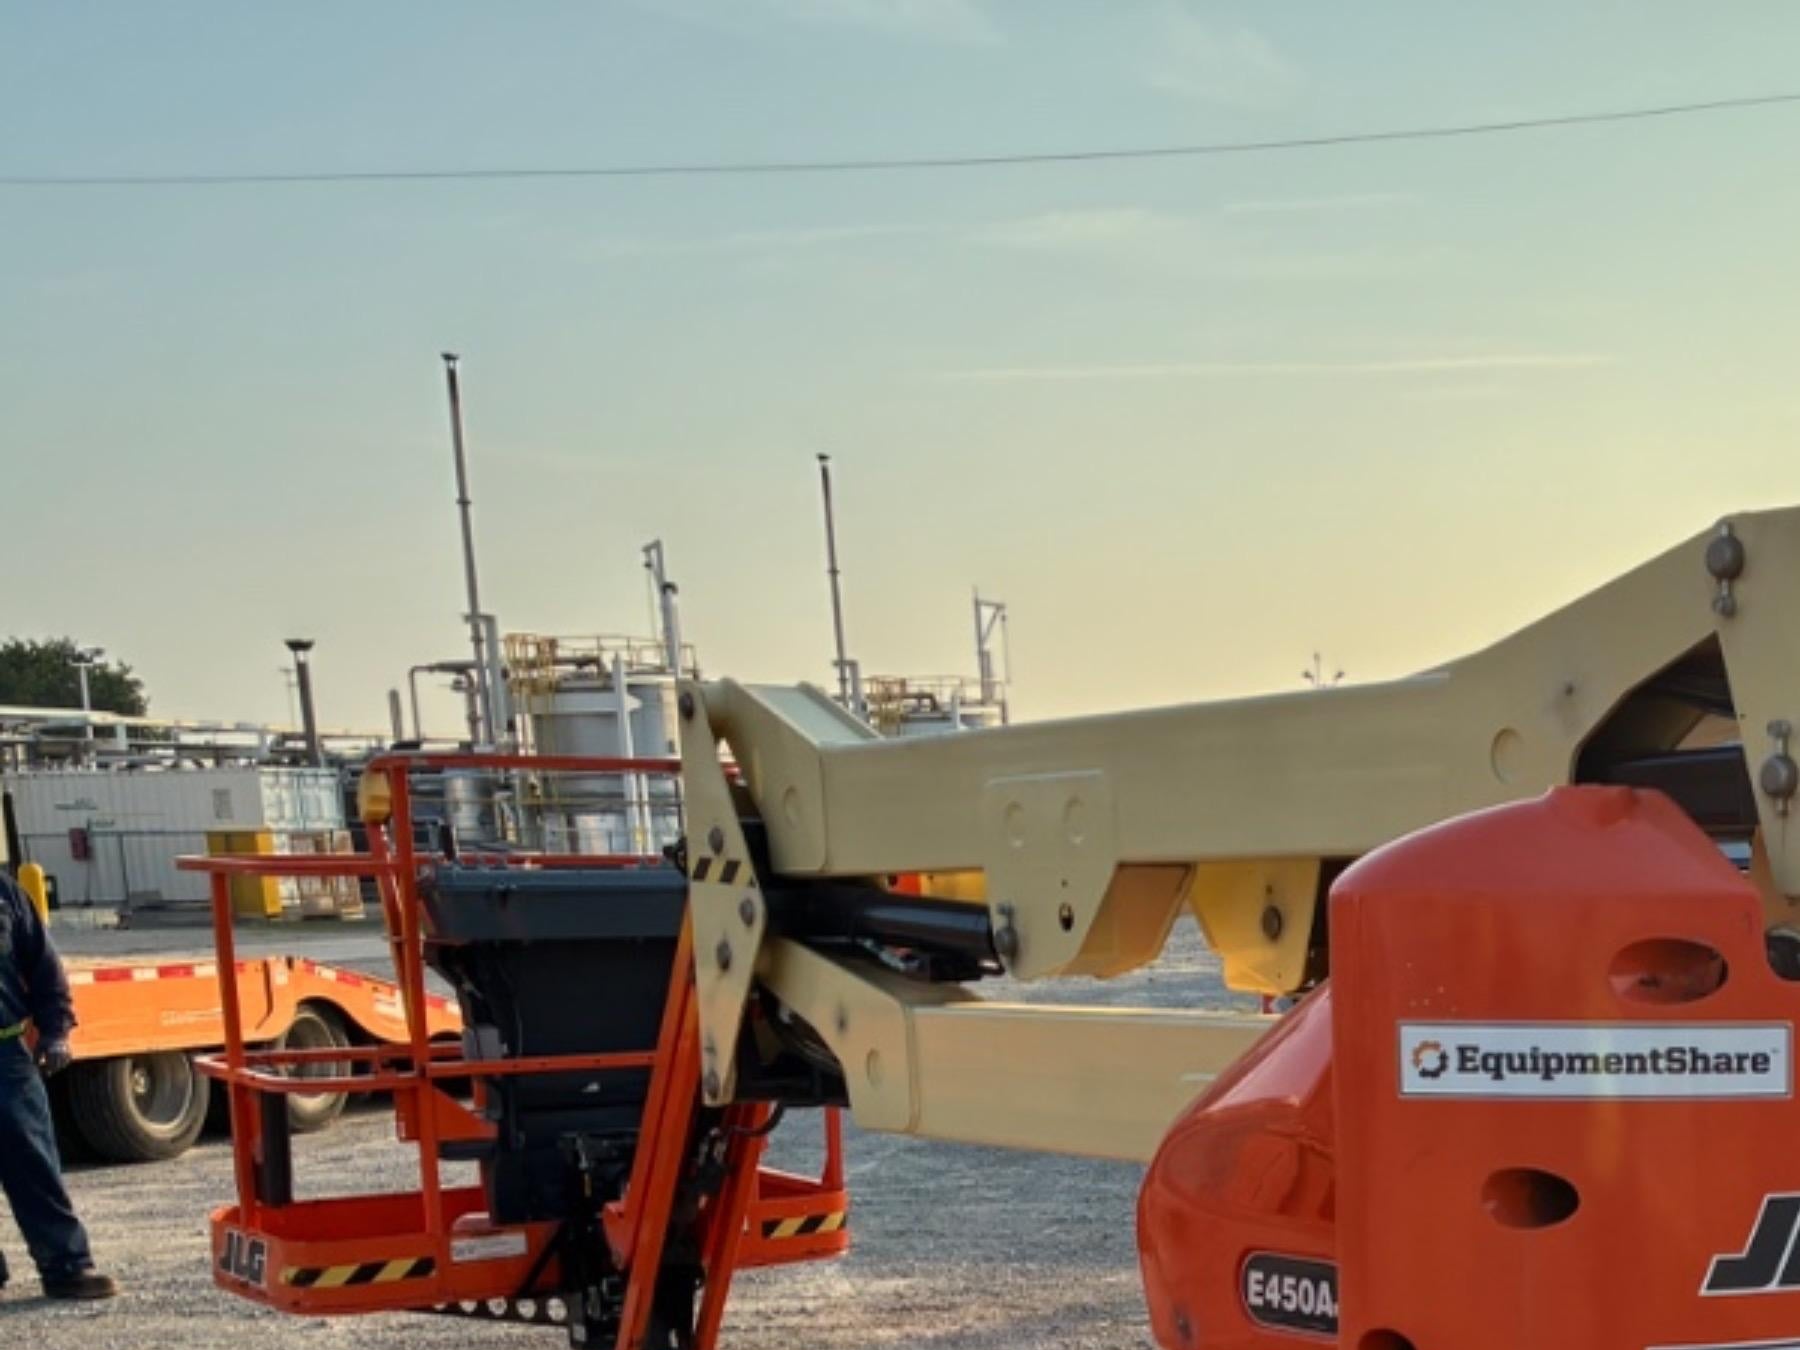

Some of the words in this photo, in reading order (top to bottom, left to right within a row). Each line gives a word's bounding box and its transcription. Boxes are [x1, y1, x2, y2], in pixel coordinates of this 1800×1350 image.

[1456, 1043, 1772, 1081] EquipmentShare
[218, 1229, 267, 1287] JLG
[1247, 1270, 1338, 1318] E450A
